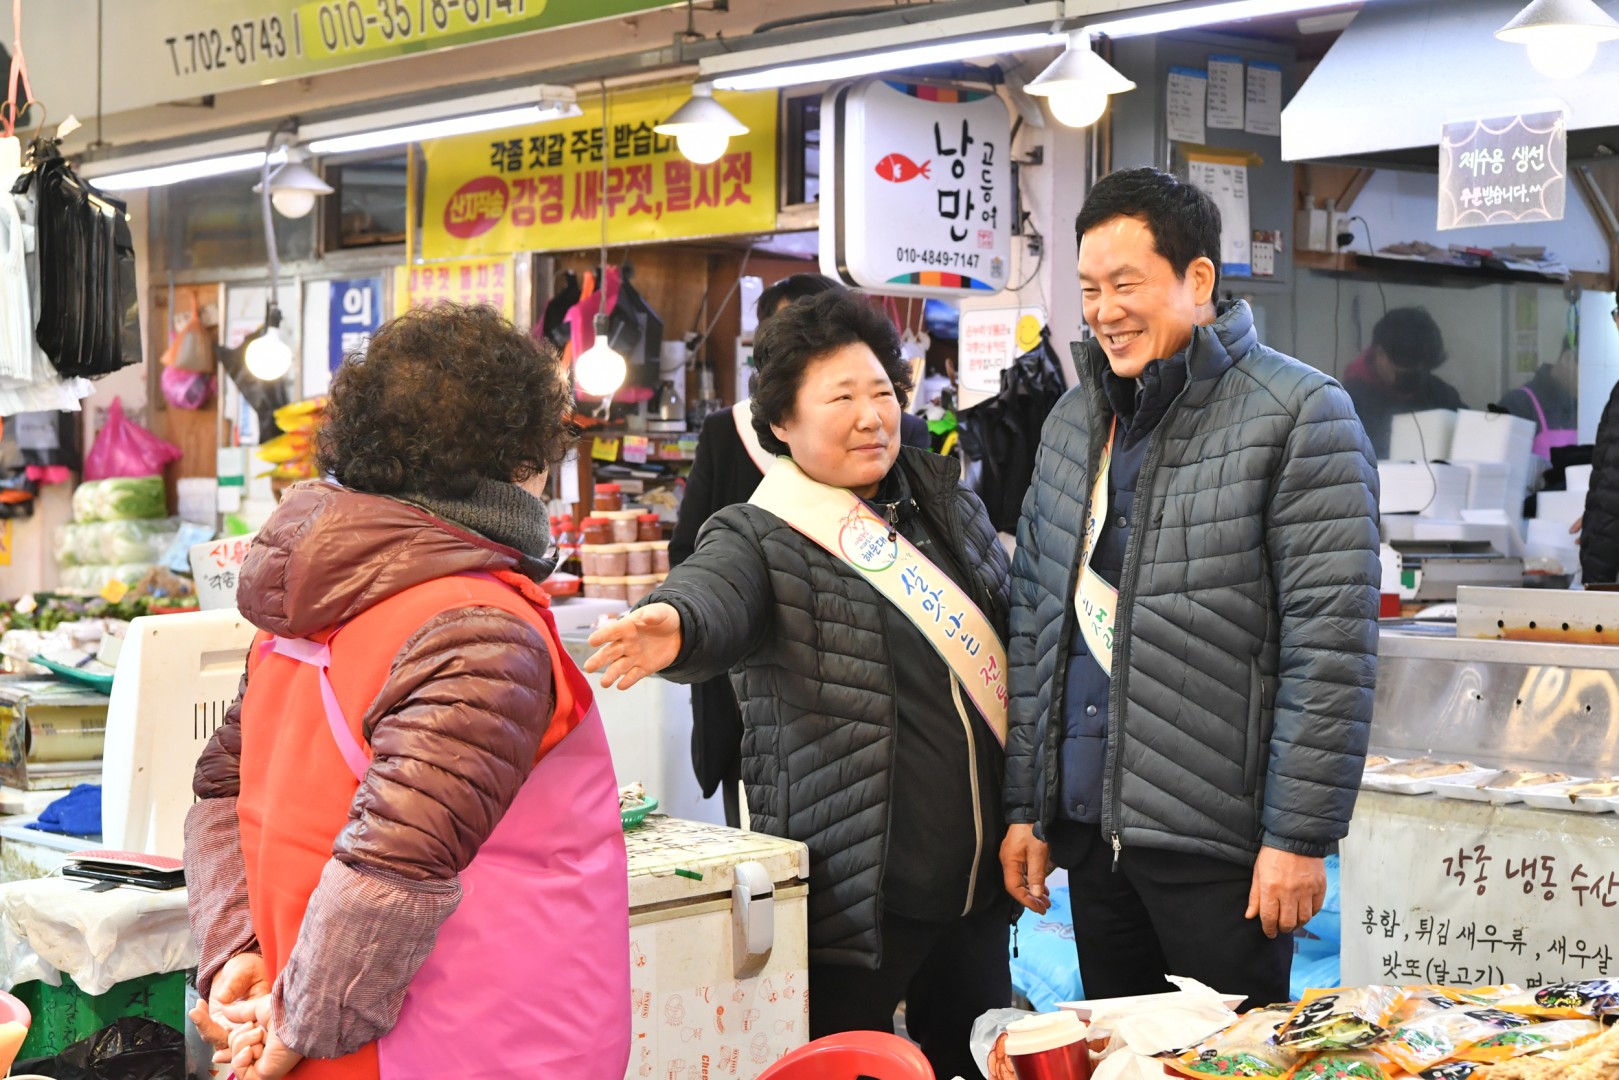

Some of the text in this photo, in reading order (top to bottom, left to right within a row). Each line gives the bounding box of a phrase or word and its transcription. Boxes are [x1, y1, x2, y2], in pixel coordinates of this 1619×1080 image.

[165, 14, 287, 77] T.702-8743
[491, 138, 523, 173] 각종
[529, 133, 566, 169] 젓갈
[1459, 144, 1545, 178] 제수용 생선
[510, 173, 563, 228] 강경
[934, 118, 974, 242] 낭만
[980, 141, 998, 229] 고등어
[896, 247, 980, 269] 010-4849-7147
[861, 536, 888, 562] 해운대
[1442, 845, 1493, 896] 각종
[1505, 855, 1558, 901] 냉동
[1547, 936, 1613, 976] 새우살
